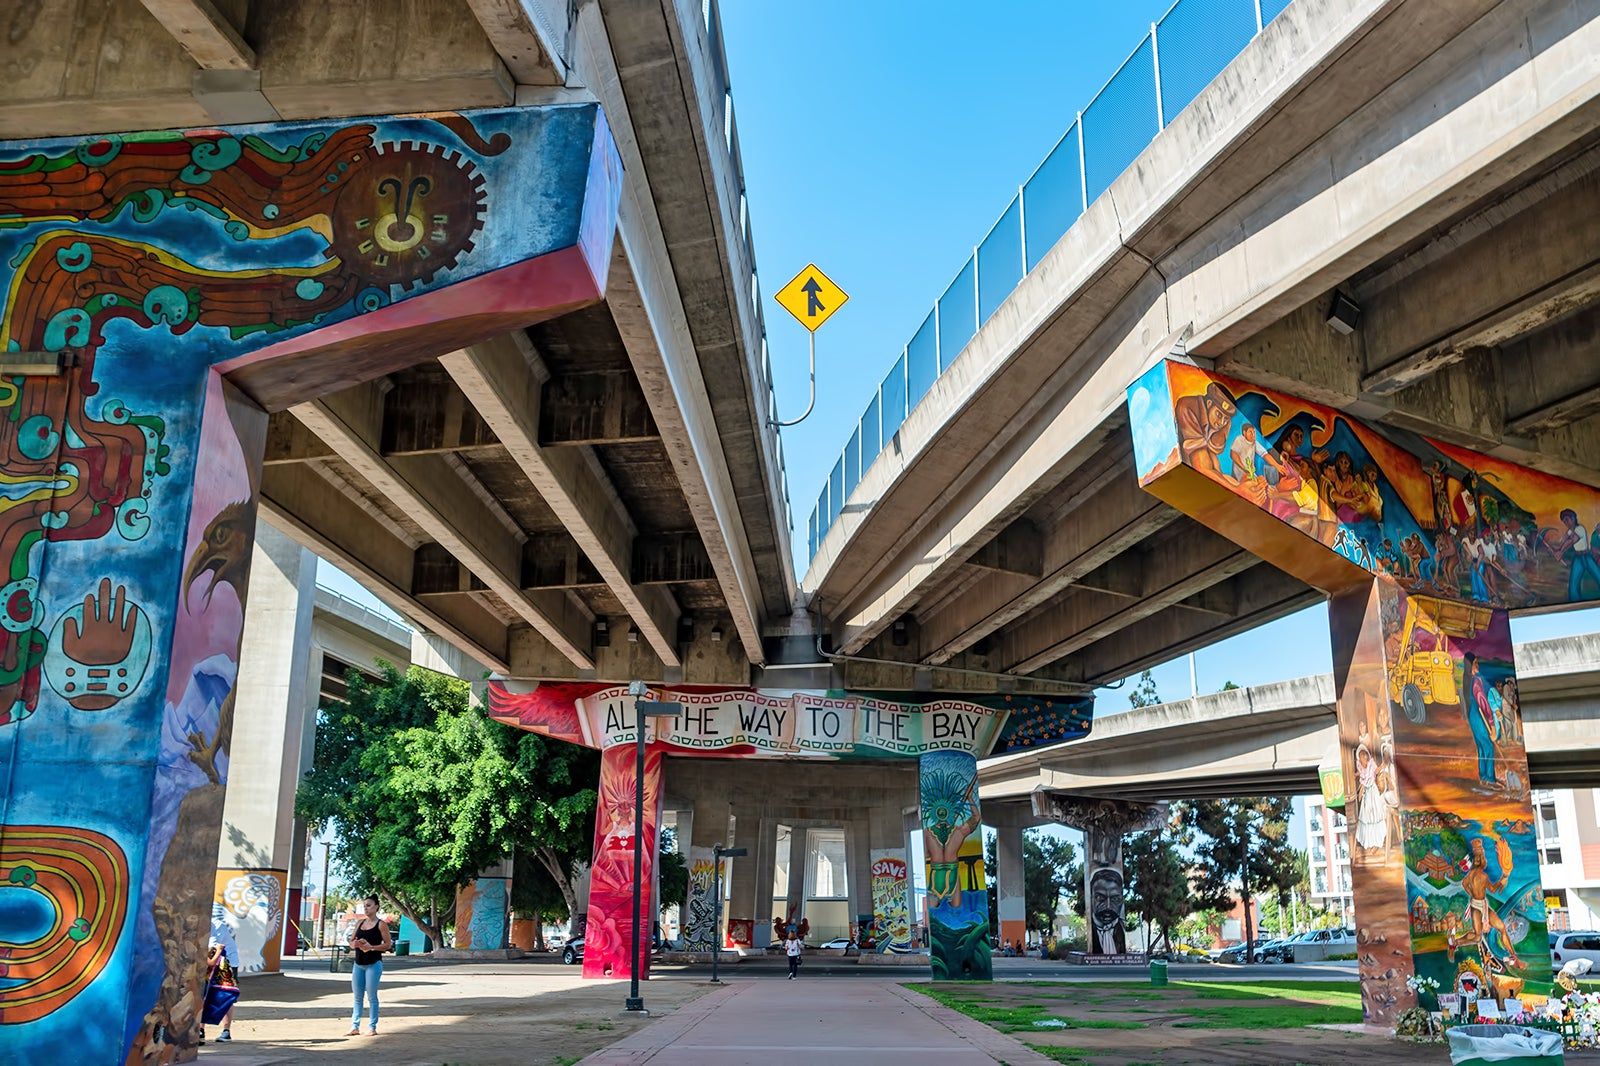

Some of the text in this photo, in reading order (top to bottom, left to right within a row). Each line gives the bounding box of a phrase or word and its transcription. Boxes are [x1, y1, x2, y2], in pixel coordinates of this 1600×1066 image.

[606, 701, 650, 734] AL
[738, 704, 787, 737] WAY
[805, 707, 840, 738] TO
[860, 707, 909, 742] THE
[932, 713, 981, 741] BAY
[688, 868, 713, 890] WHY
[873, 862, 905, 877] SAVE
